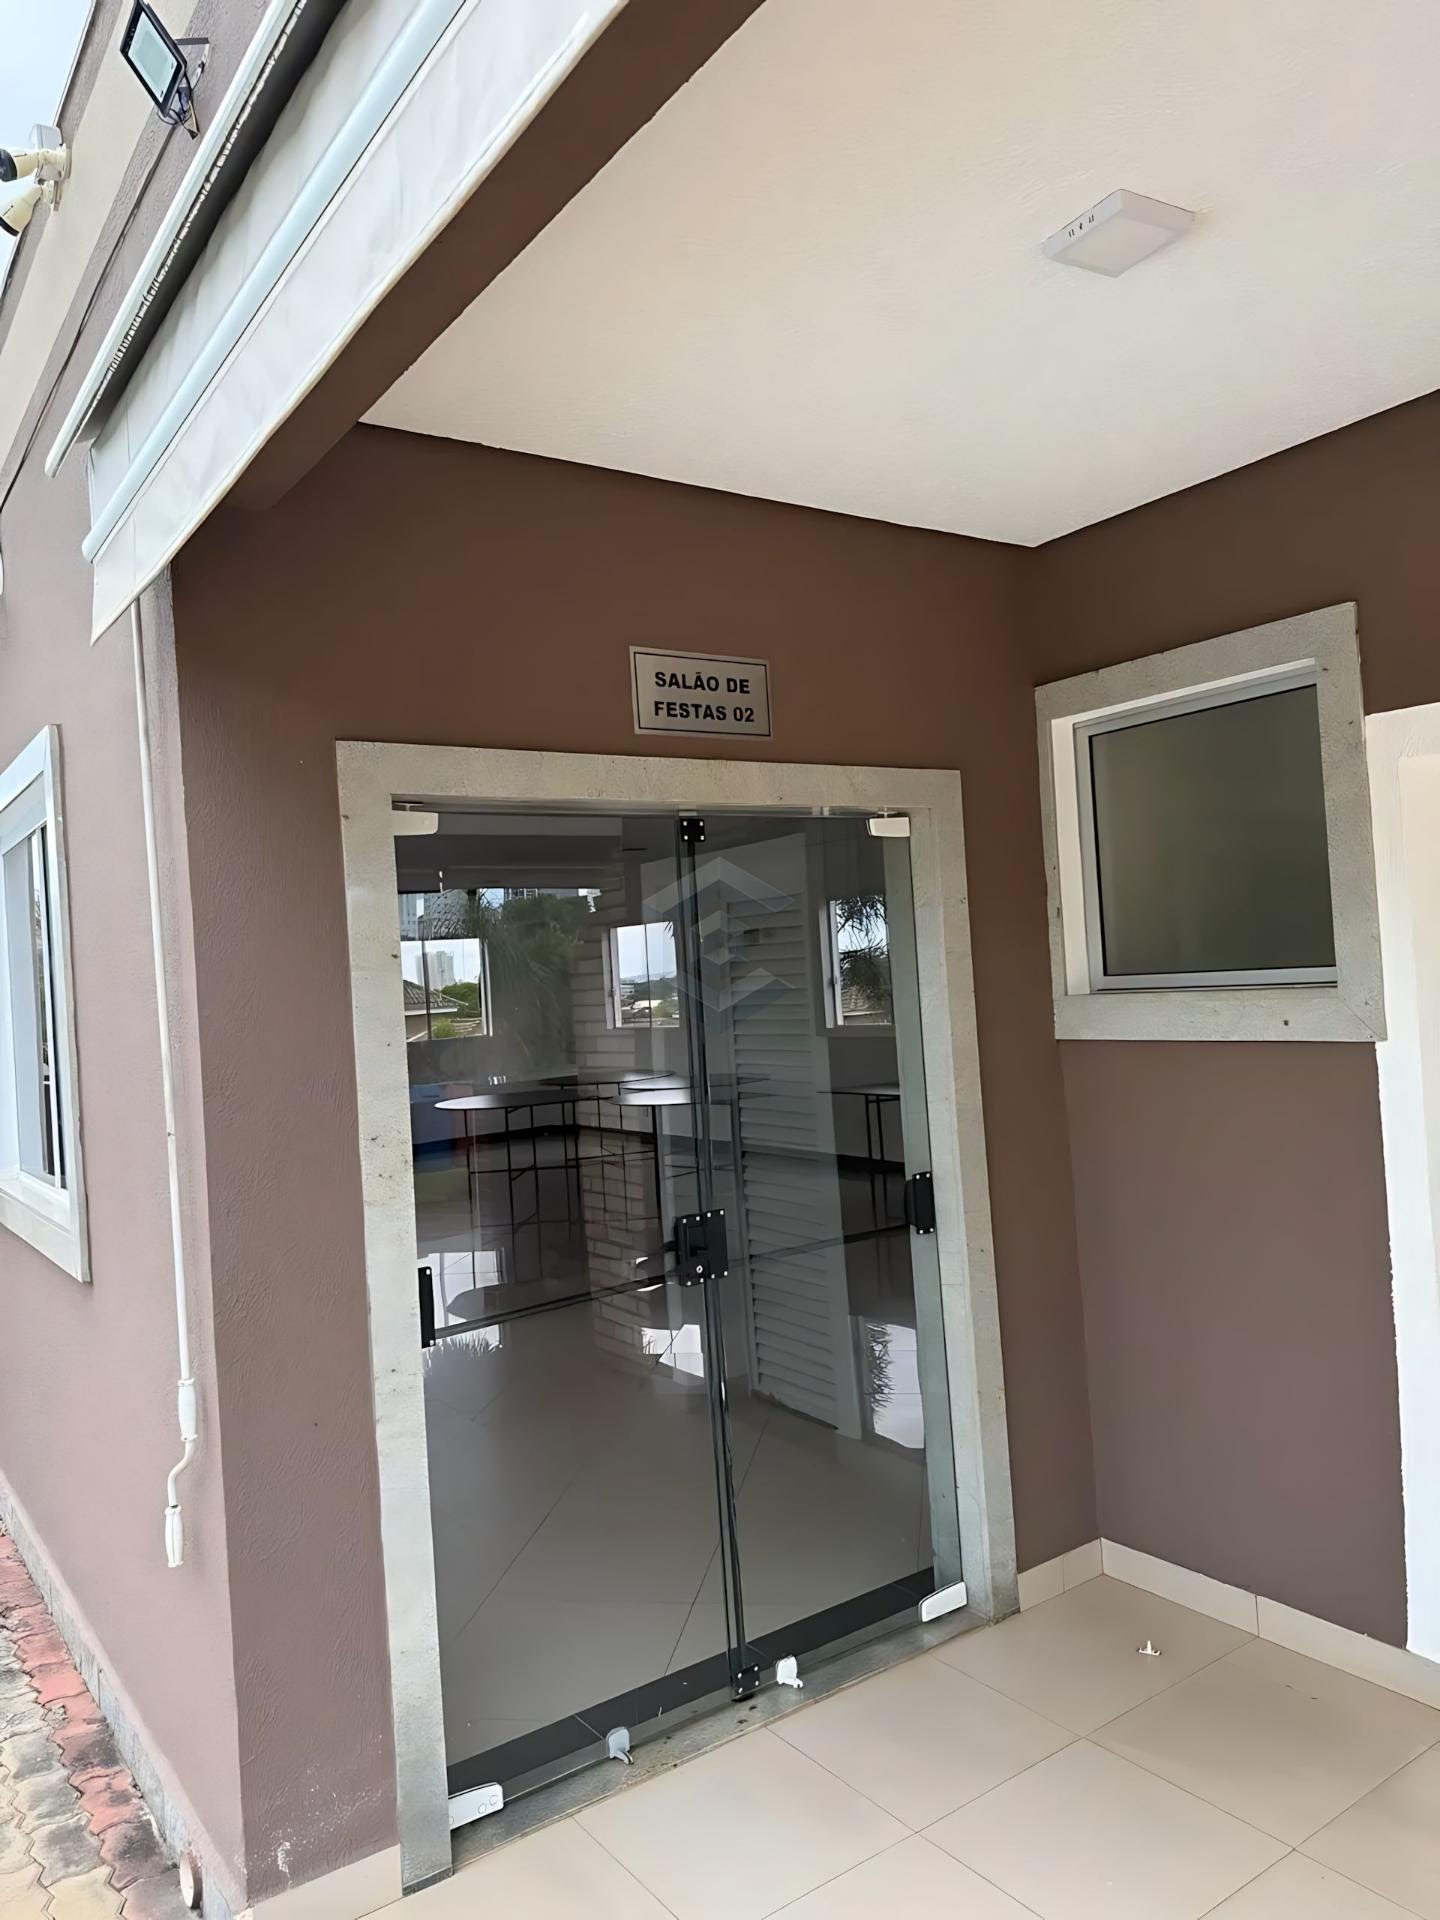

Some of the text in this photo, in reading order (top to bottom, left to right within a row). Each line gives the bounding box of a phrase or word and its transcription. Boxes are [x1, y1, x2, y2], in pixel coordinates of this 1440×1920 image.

[655, 672, 750, 694] SALÃO DE
[654, 701, 754, 722] FESTAS 02
